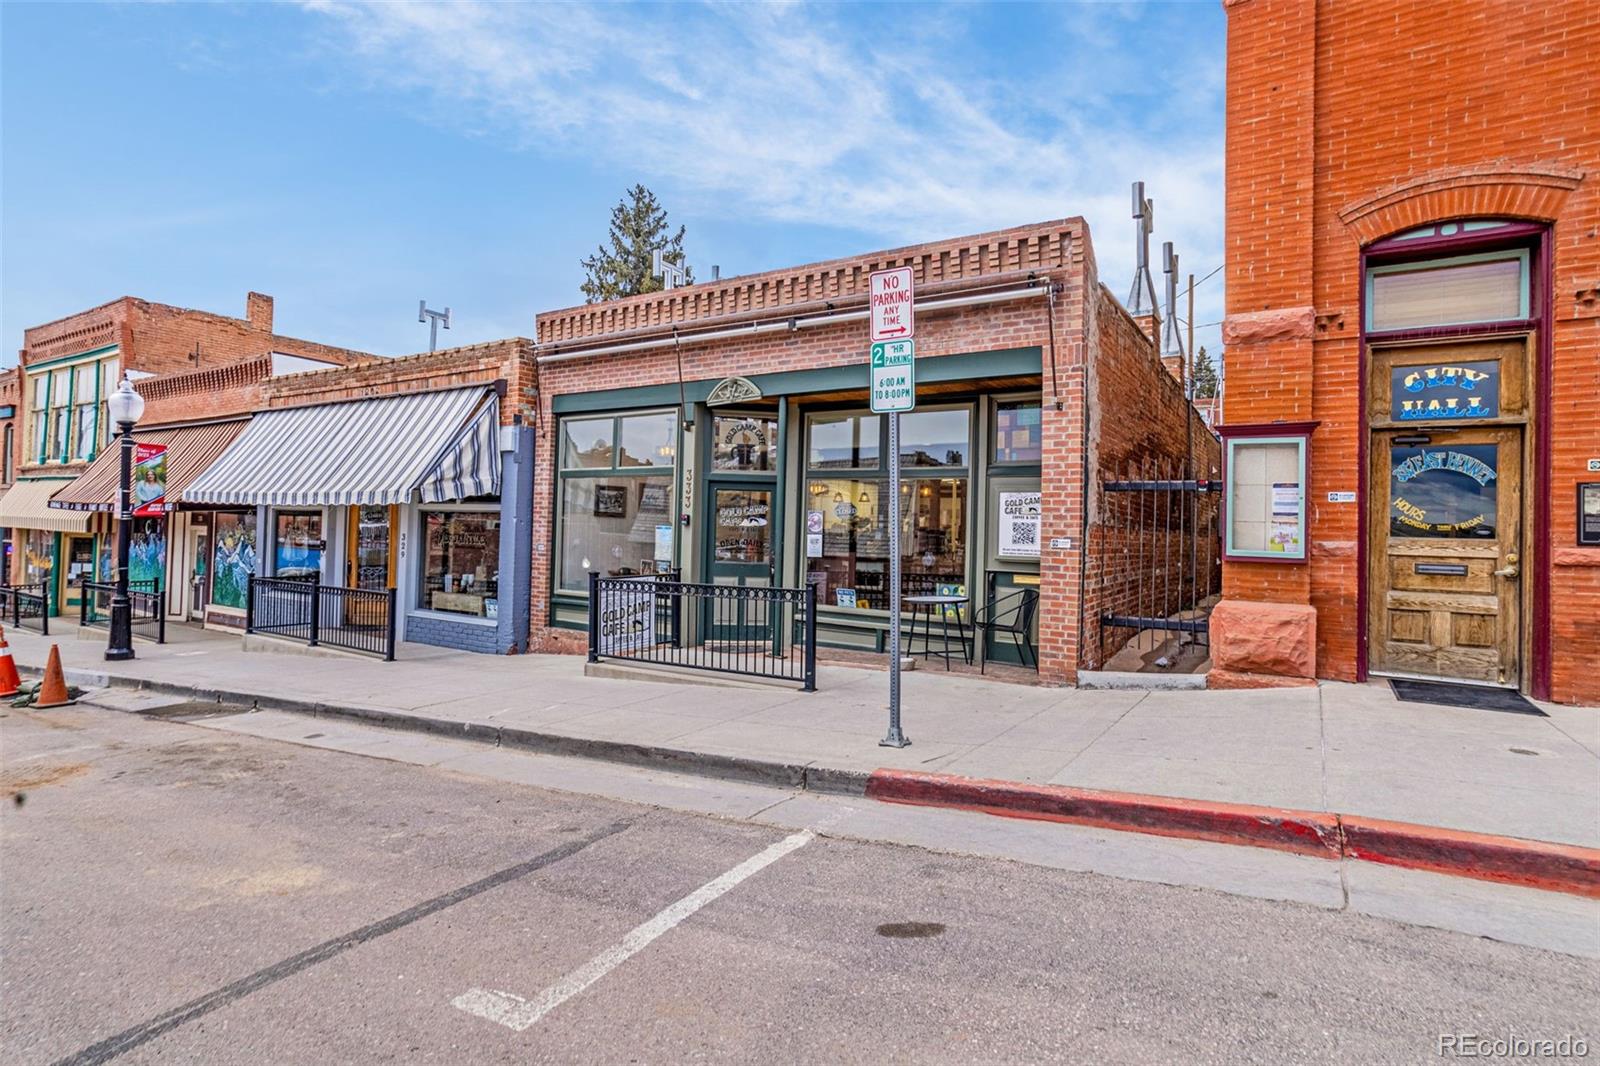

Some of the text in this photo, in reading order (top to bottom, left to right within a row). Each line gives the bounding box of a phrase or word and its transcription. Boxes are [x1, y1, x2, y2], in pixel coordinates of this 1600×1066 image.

[883, 275, 899, 290] NO
[873, 290, 910, 307] PARKING
[883, 306, 899, 315] ANY
[883, 315, 901, 326] TIME
[873, 344, 905, 364] 2 HR
[885, 354, 911, 365] PARKING
[879, 376, 905, 388] 6:00 AM
[1404, 367, 1490, 392] CITY
[875, 388, 910, 399] TO 8:00 PM
[1400, 397, 1490, 419] HALL
[725, 427, 737, 445] GOLD
[1409, 449, 1446, 473] EAST
[1004, 496, 1041, 507] GOLD CAM
[1393, 497, 1426, 521] HOURS
[720, 507, 742, 517] GOLD
[1004, 507, 1023, 515] CAFE
[1398, 515, 1432, 531] MONDAY
[1455, 513, 1485, 531] FRIDAY
[602, 607, 625, 623] GOLD
